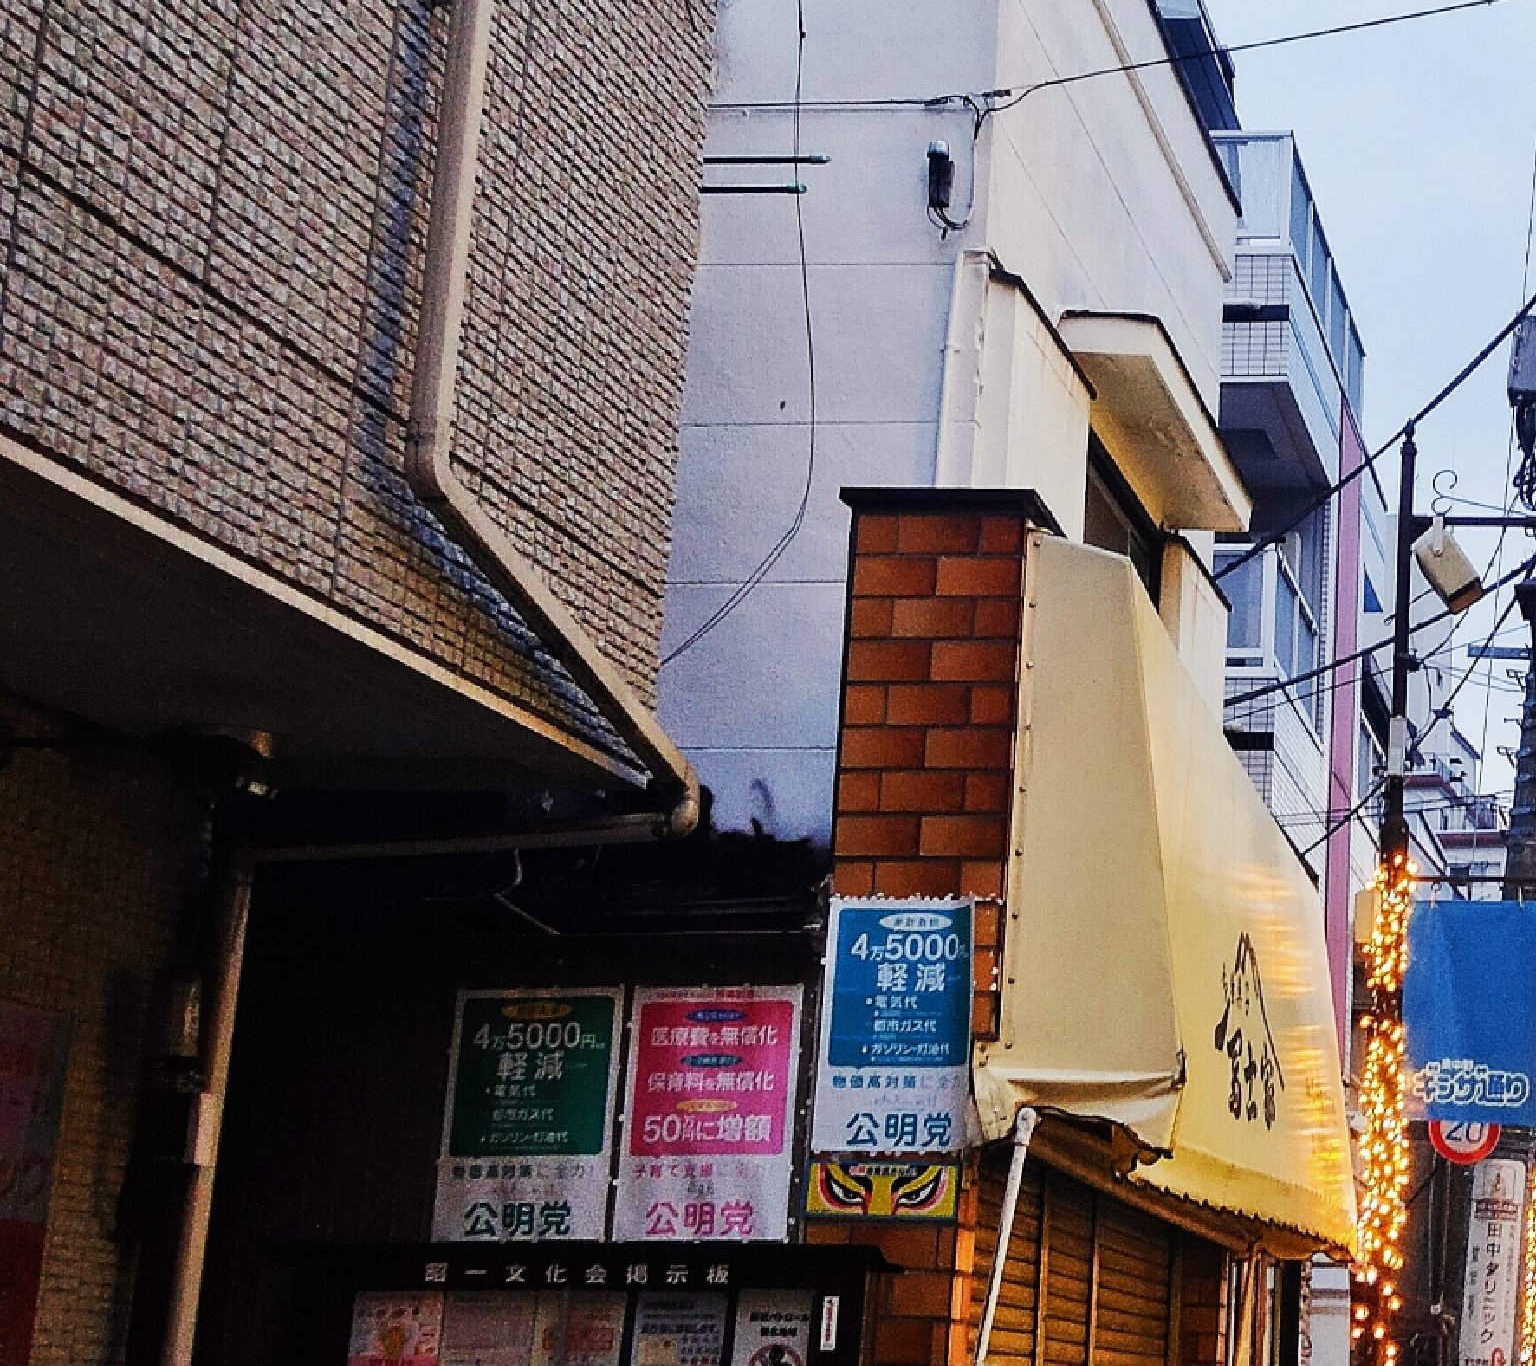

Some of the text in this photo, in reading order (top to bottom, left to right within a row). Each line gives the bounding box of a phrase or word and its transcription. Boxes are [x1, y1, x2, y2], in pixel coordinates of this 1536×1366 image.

[876, 963, 946, 992] 軽減
[496, 1051, 565, 1081] 軽減
[845, 1112, 952, 1147] 公明党
[1446, 1121, 1483, 1143] 20
[463, 1200, 572, 1237] 公明党
[645, 1199, 755, 1237] 公明党
